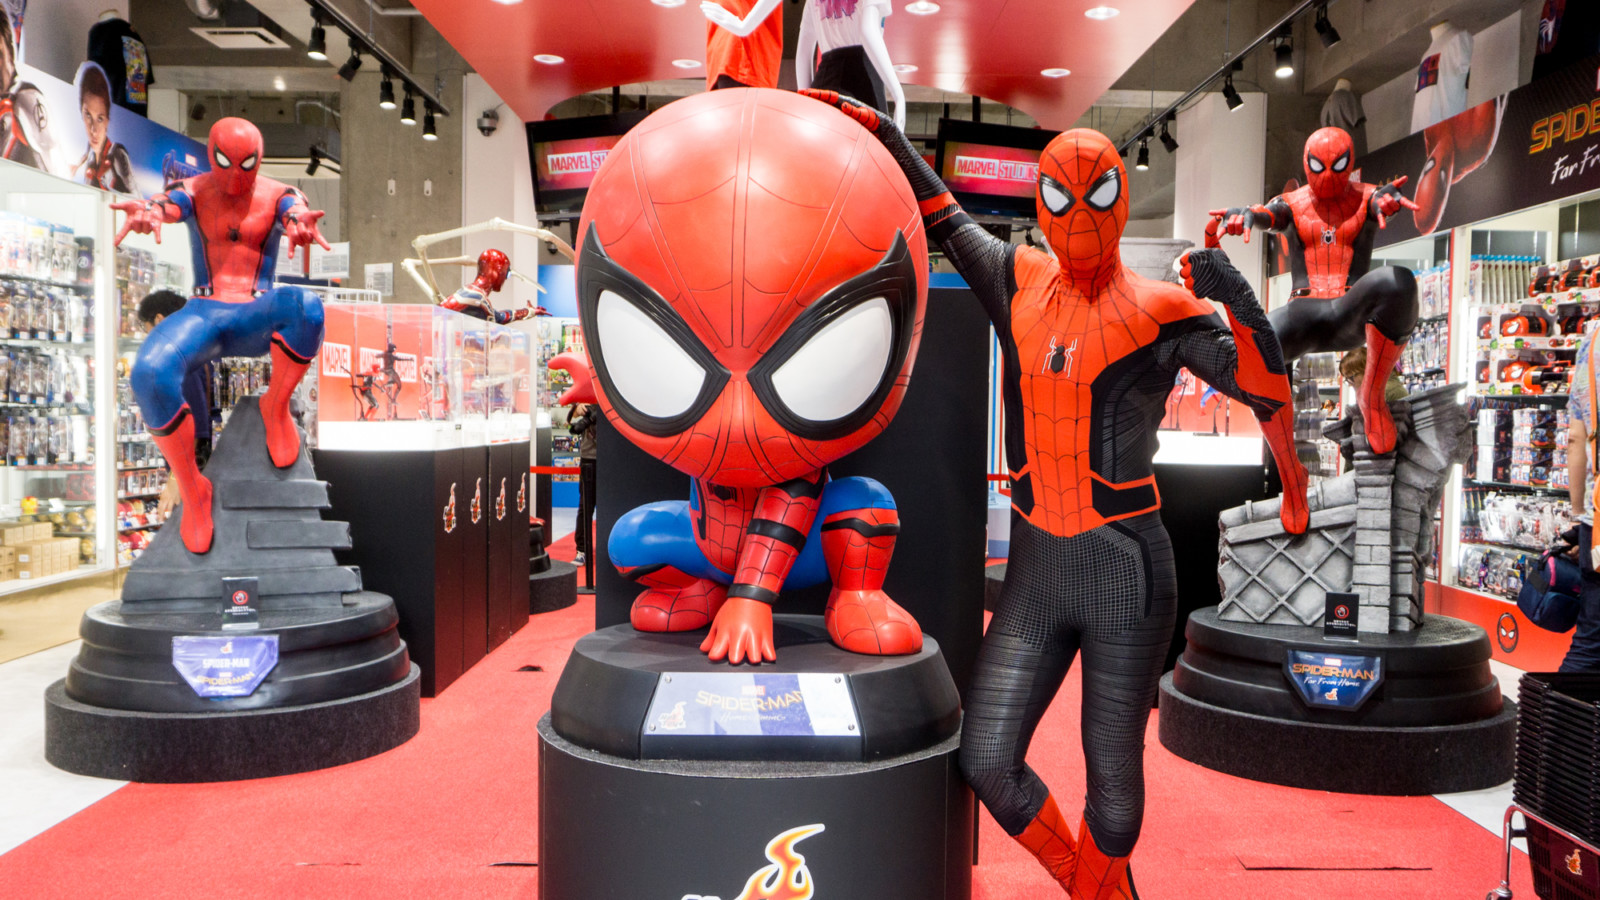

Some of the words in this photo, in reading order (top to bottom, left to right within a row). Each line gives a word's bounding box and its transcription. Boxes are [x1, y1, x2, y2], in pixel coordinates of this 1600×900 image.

[551, 154, 590, 171] MARVEL
[957, 159, 996, 176] MARVEL
[1000, 162, 1039, 180] STUDIOS
[1551, 154, 1578, 185] Far
[323, 342, 348, 376] MARVEL
[203, 657, 250, 668] SPIDER-MAN
[1291, 664, 1375, 680] SPIDER-MAN
